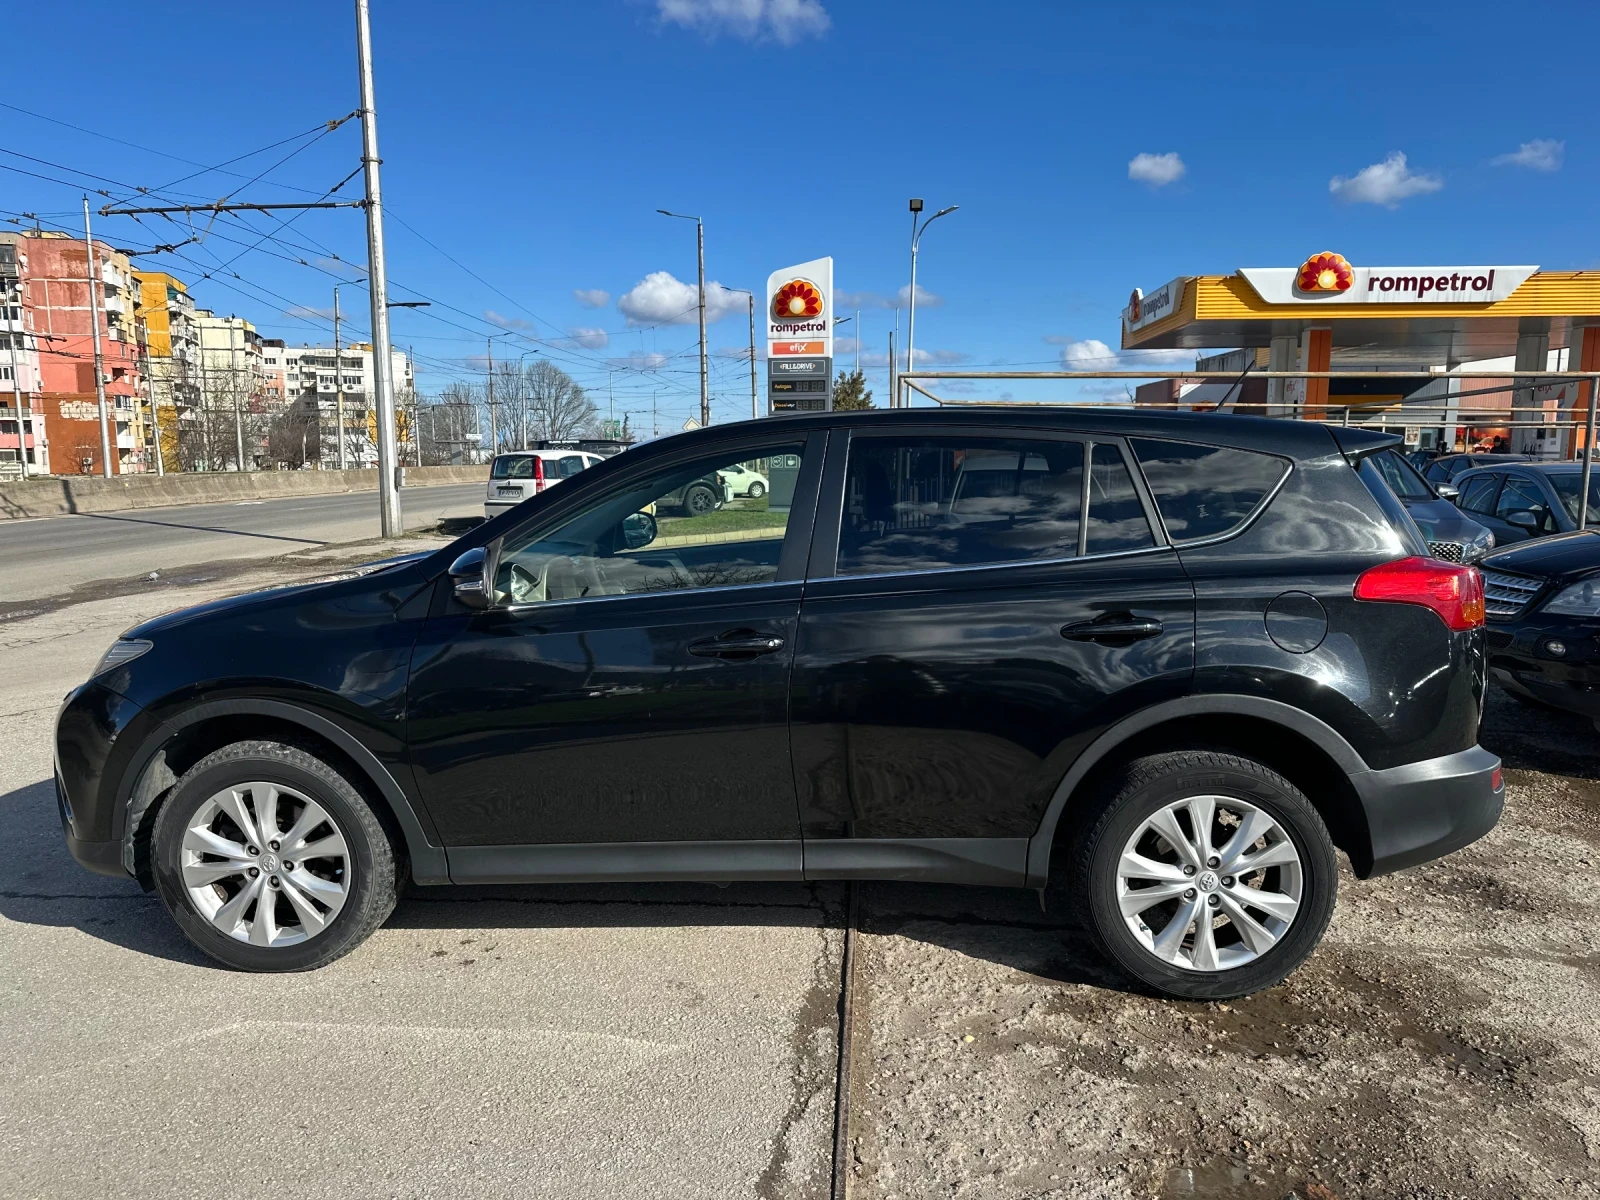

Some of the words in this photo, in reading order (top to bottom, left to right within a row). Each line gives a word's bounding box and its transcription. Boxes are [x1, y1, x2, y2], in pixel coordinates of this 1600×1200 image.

[1368, 269, 1495, 298] rompetrol
[771, 320, 826, 335] rompetrol
[789, 343, 808, 353] efix
[782, 362, 813, 370] FILL&DRIVE
